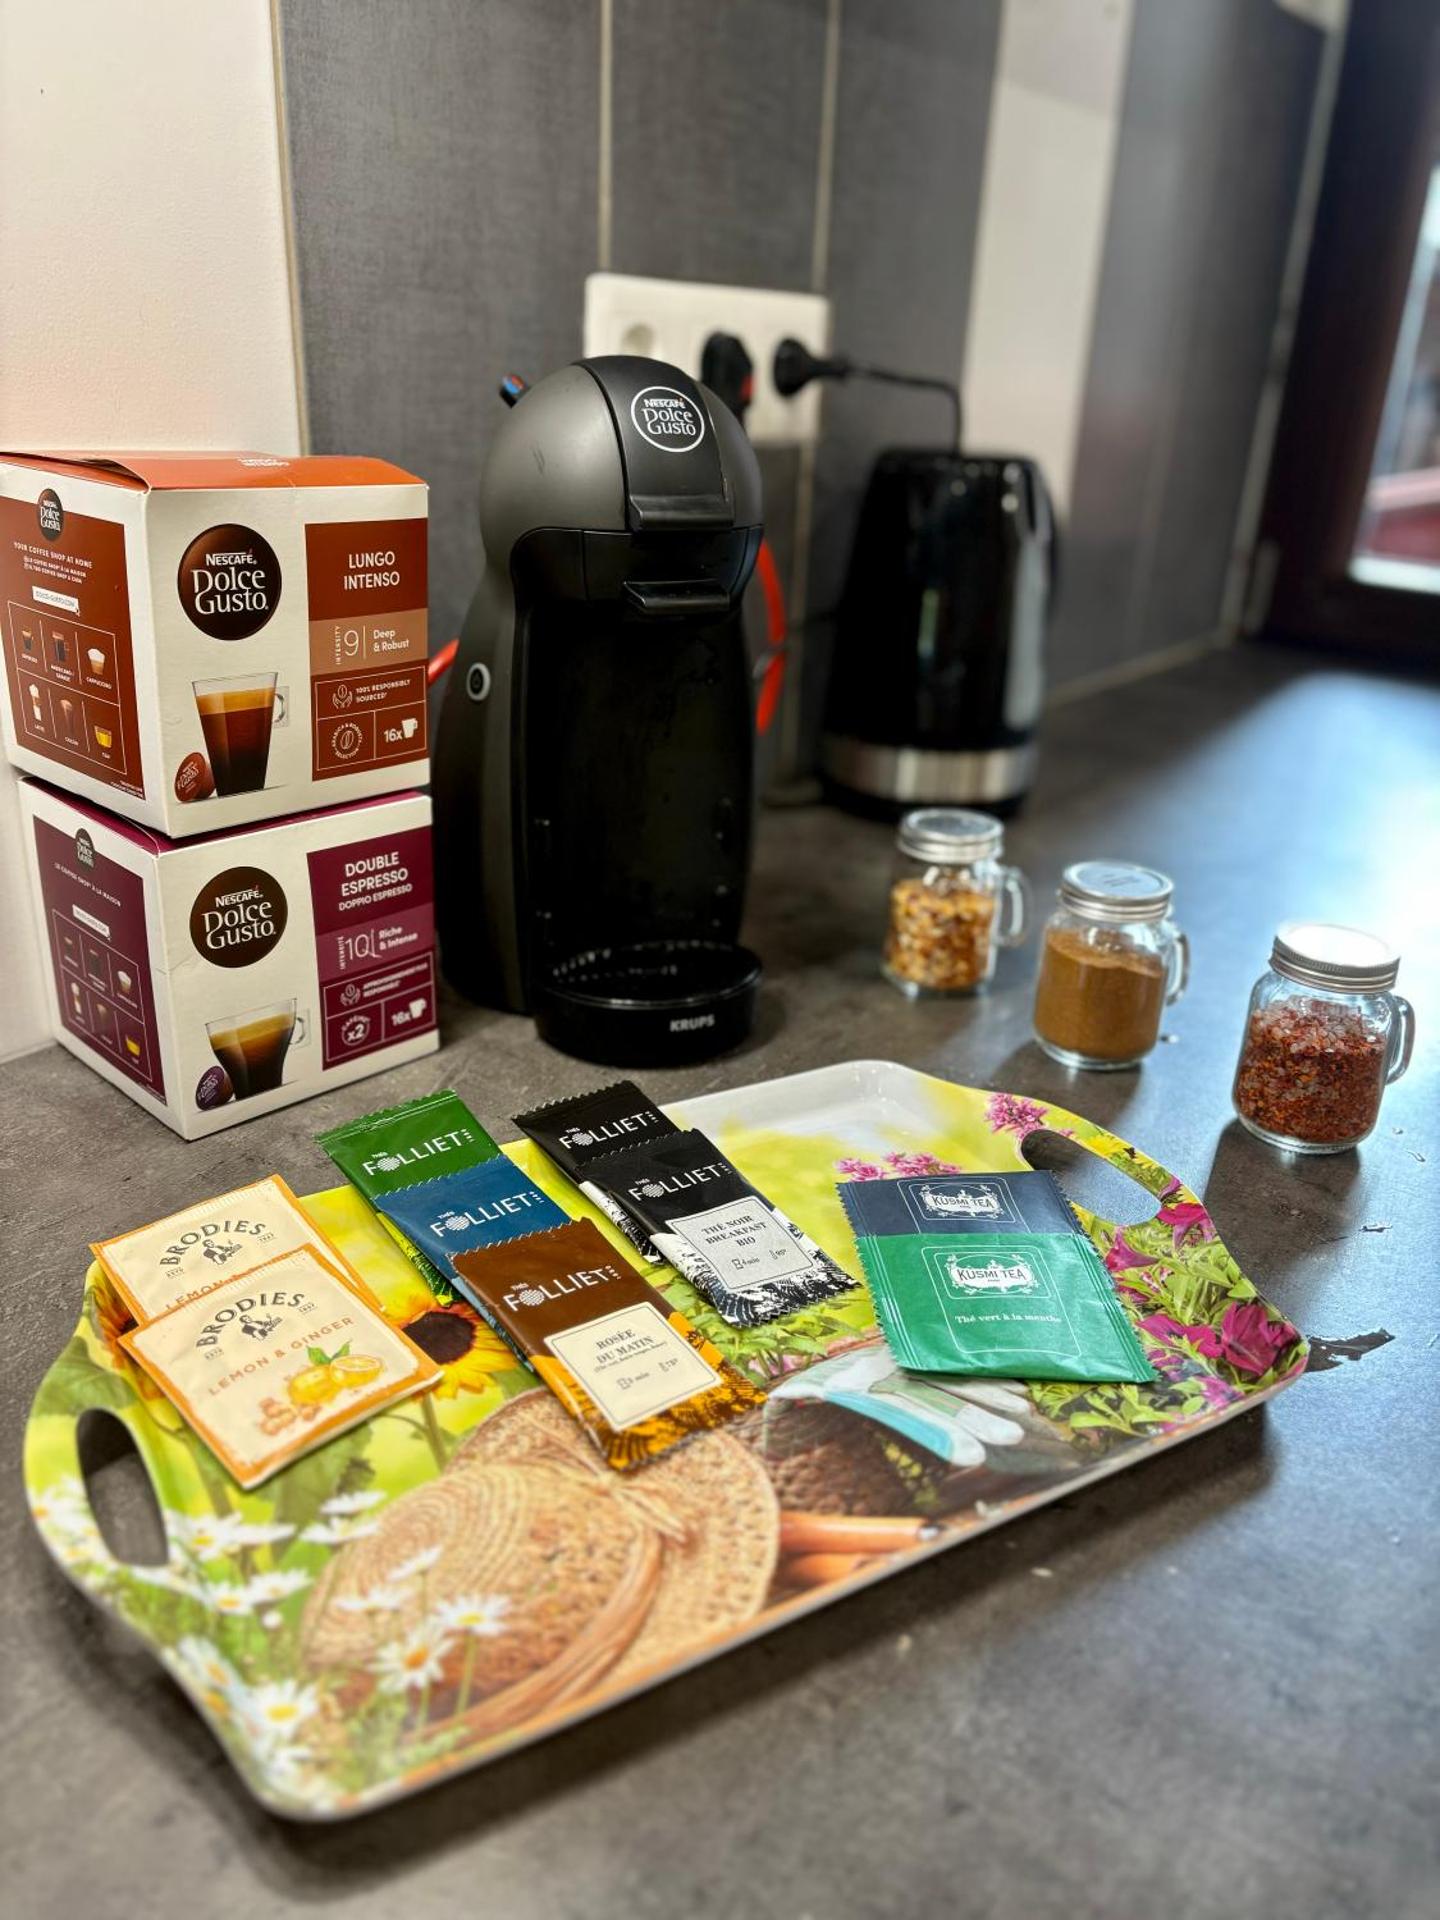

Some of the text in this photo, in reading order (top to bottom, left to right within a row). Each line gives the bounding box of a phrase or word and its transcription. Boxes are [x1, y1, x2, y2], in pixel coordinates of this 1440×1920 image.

[641, 407, 694, 424] Dolce
[647, 420, 697, 436] Gusto
[348, 551, 396, 569] LUNGO
[190, 567, 266, 593] Dolce
[343, 571, 401, 590] INTENSO
[195, 588, 268, 615] Gusto
[344, 630, 359, 656] 9
[373, 629, 396, 640] Deep
[373, 639, 410, 652] & Robust
[384, 728, 403, 743] 16x
[345, 851, 400, 877] DOUBLE
[341, 868, 409, 897] ESPRESSO
[338, 883, 413, 911] DOPPIO ESPRESSO
[201, 901, 273, 932] Dolce
[206, 919, 275, 949] Gusto
[347, 1023, 365, 1042] x2
[669, 1013, 716, 1033] KRUPS
[559, 1113, 648, 1149] FOLLIET
[362, 1131, 462, 1176] FOLLIET
[628, 1164, 721, 1201] FOLLIET
[430, 1192, 532, 1238] FOLLIET
[931, 1195, 995, 1209] KUSMI TEA
[705, 1221, 767, 1245] BREAKFAST
[726, 1215, 754, 1227] NOIR
[159, 1220, 267, 1265] BRODIES
[735, 1235, 757, 1247] BIO
[957, 1268, 1027, 1281] KUSMI TEA
[502, 1268, 610, 1312] FOLLIET
[195, 1292, 305, 1348] BRODIES
[208, 1316, 355, 1396] LEMON & GINGER
[596, 1350, 616, 1364] DU
[615, 1336, 655, 1356] MATIN
